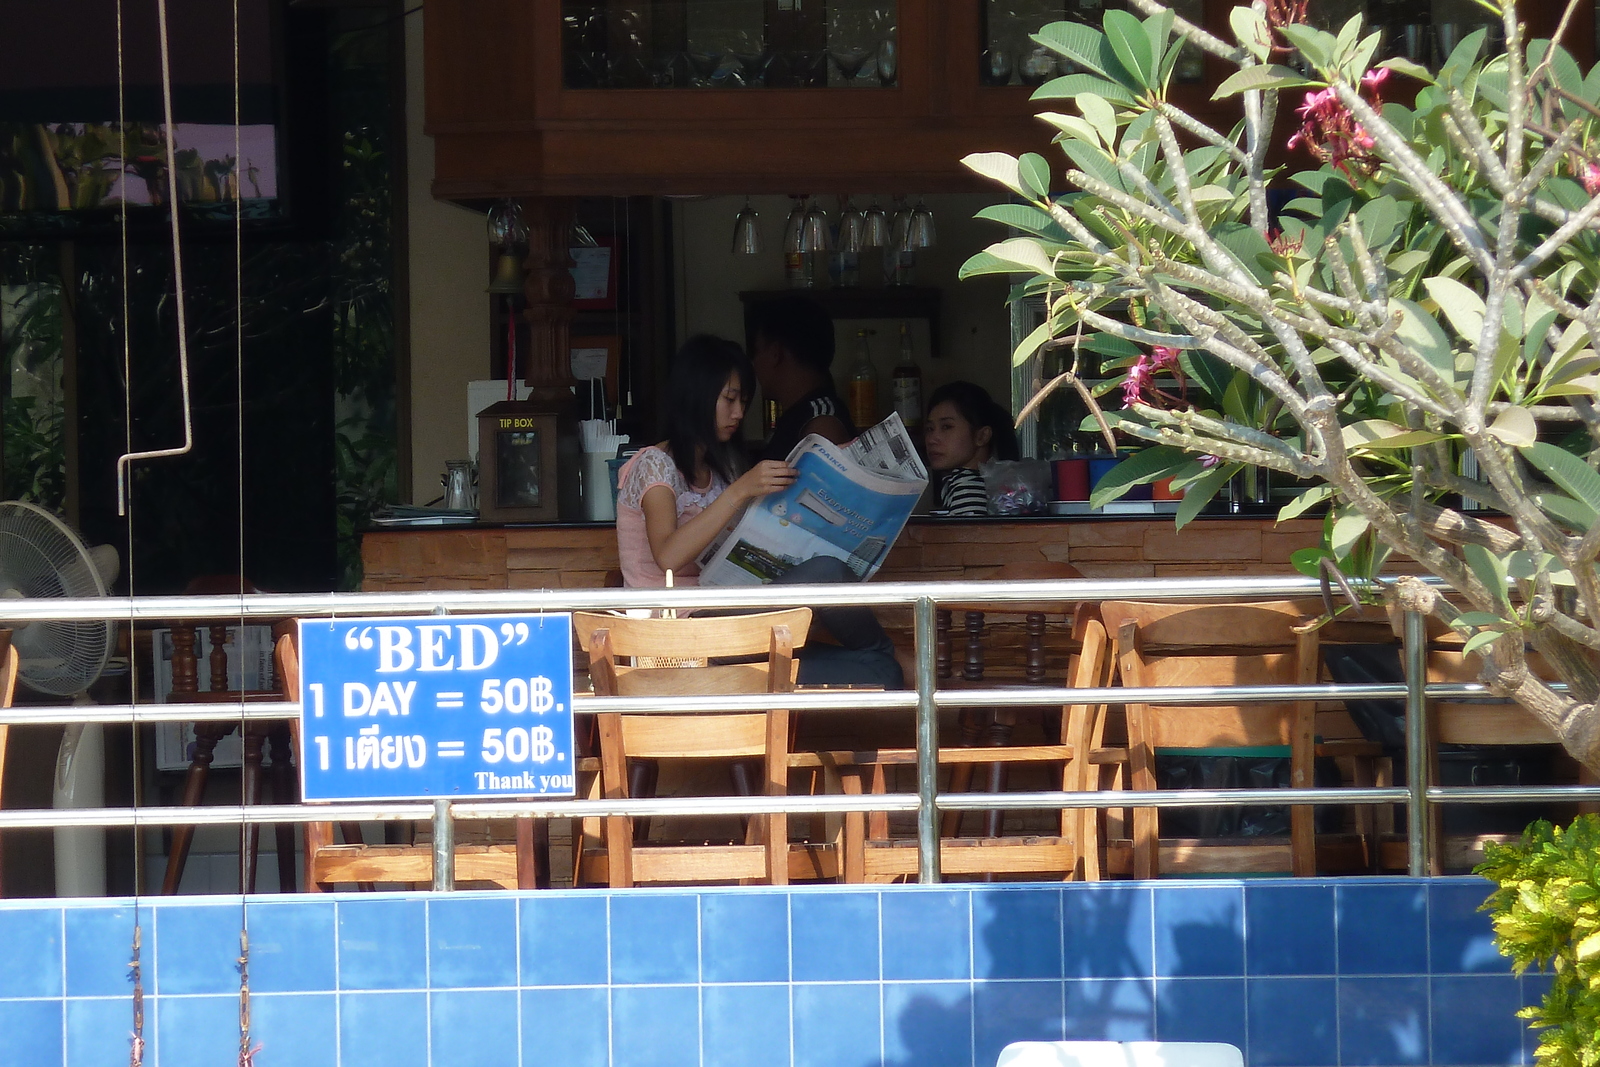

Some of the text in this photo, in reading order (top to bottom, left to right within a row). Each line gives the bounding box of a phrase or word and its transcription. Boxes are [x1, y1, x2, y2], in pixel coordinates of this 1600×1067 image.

[499, 418, 534, 428] TIP BOX
[818, 447, 848, 472] DAIKIN
[817, 488, 875, 526] Everywhere
[843, 526, 863, 539] you
[309, 683, 324, 717] 1
[343, 681, 417, 716] DAY
[436, 692, 464, 707] =
[315, 736, 329, 770] 1
[345, 724, 427, 770] เตียง
[437, 741, 464, 757] =
[474, 771, 573, 793] Thank you
